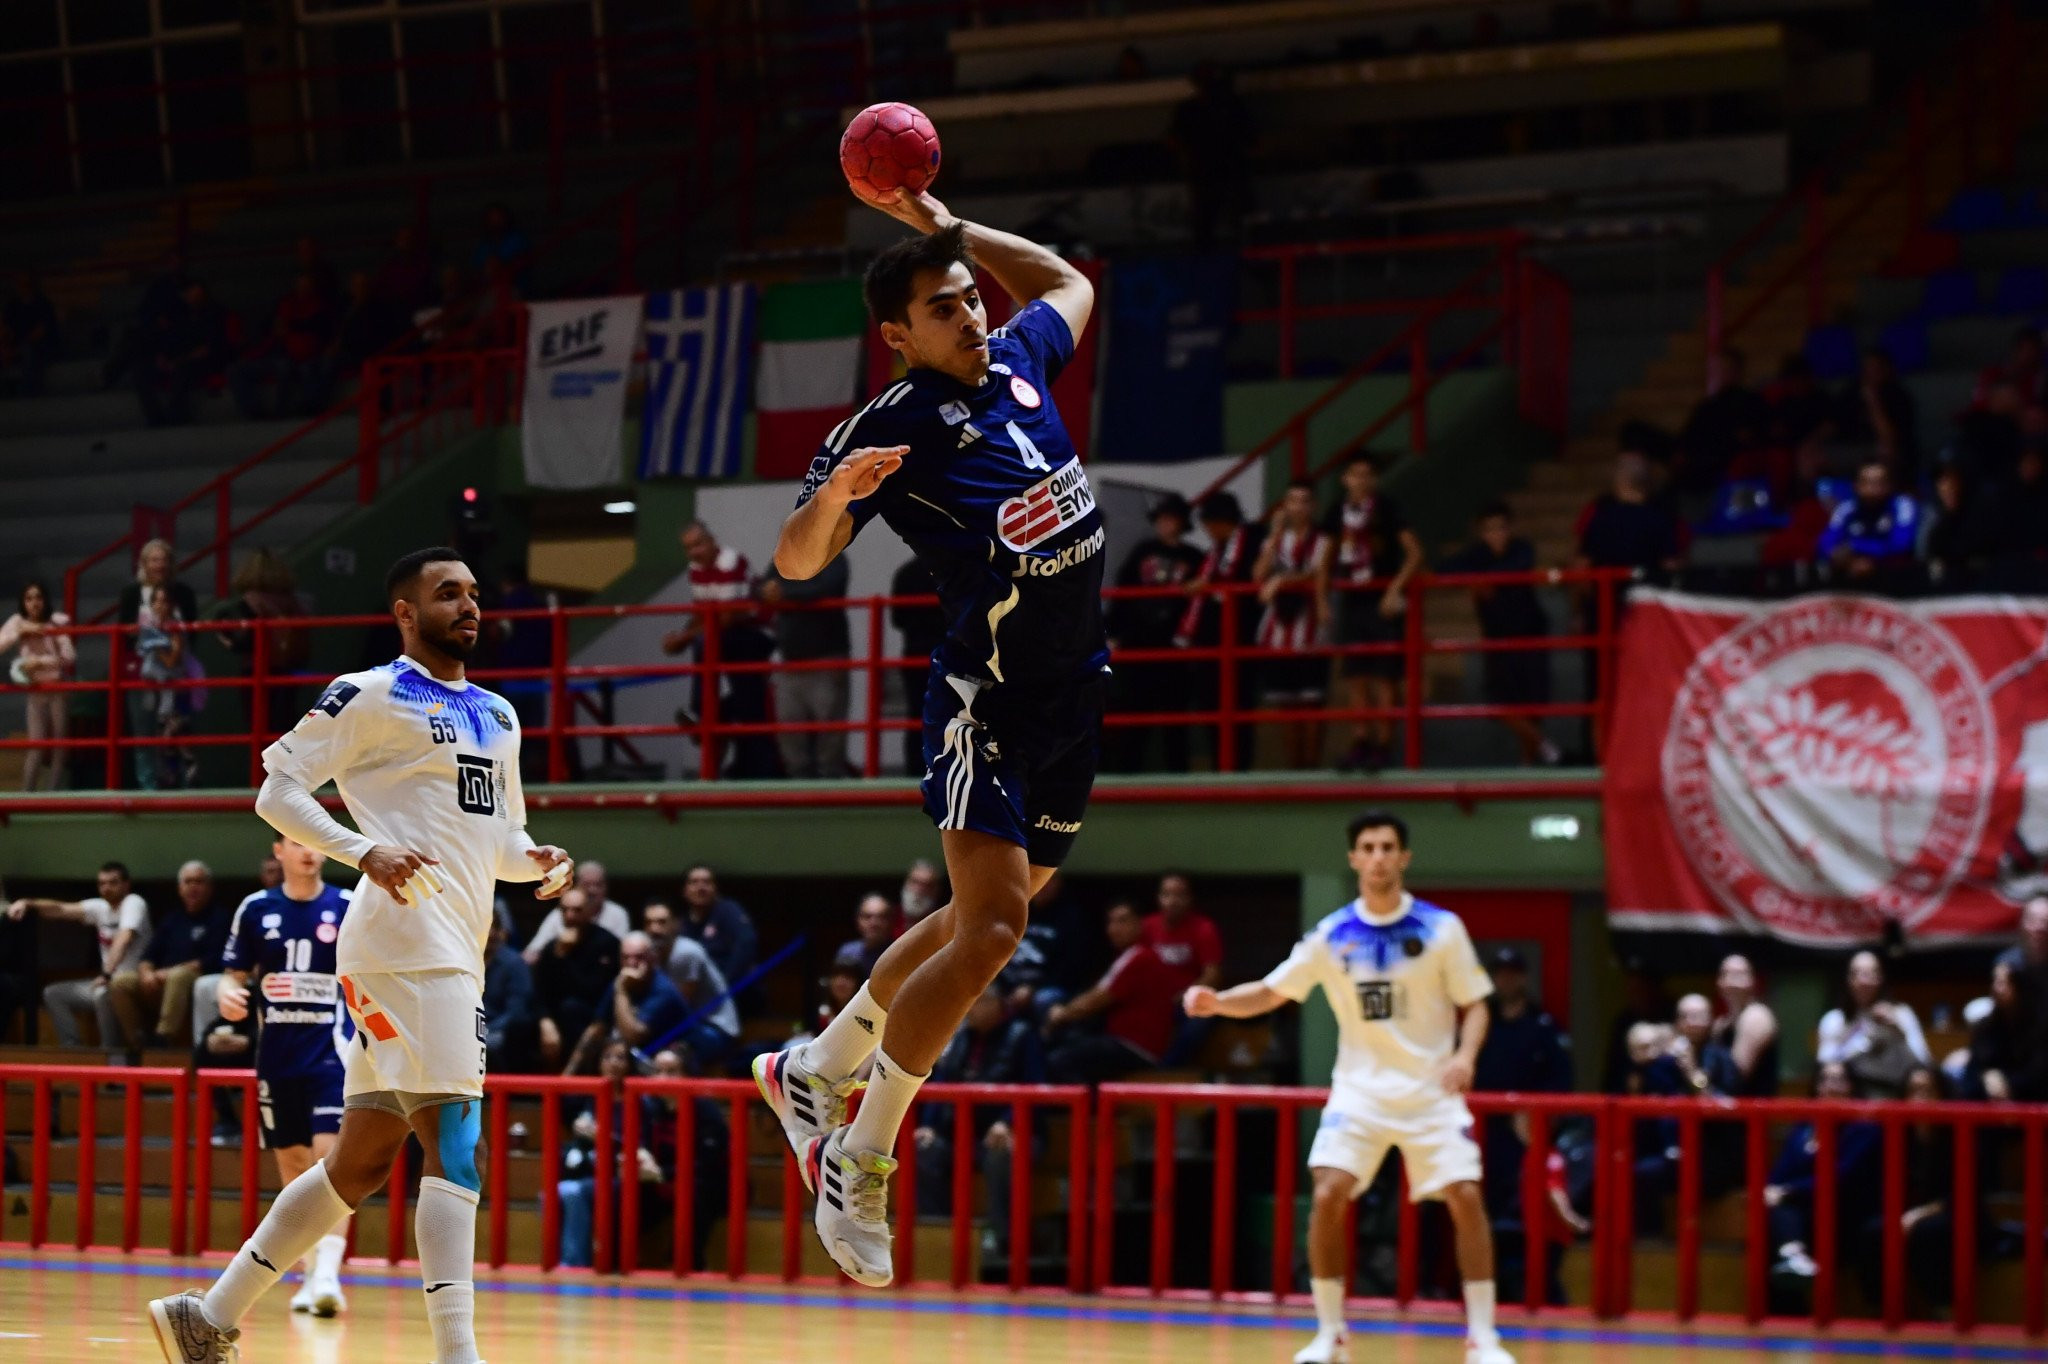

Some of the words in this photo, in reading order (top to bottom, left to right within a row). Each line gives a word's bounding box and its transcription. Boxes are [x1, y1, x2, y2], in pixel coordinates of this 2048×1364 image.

[541, 309, 610, 358] EHF
[1005, 420, 1052, 472] 4
[1056, 481, 1092, 522] ΞΥΝ
[1011, 525, 1105, 578] Stoixima
[428, 716, 457, 744] 55
[284, 938, 313, 973] 10
